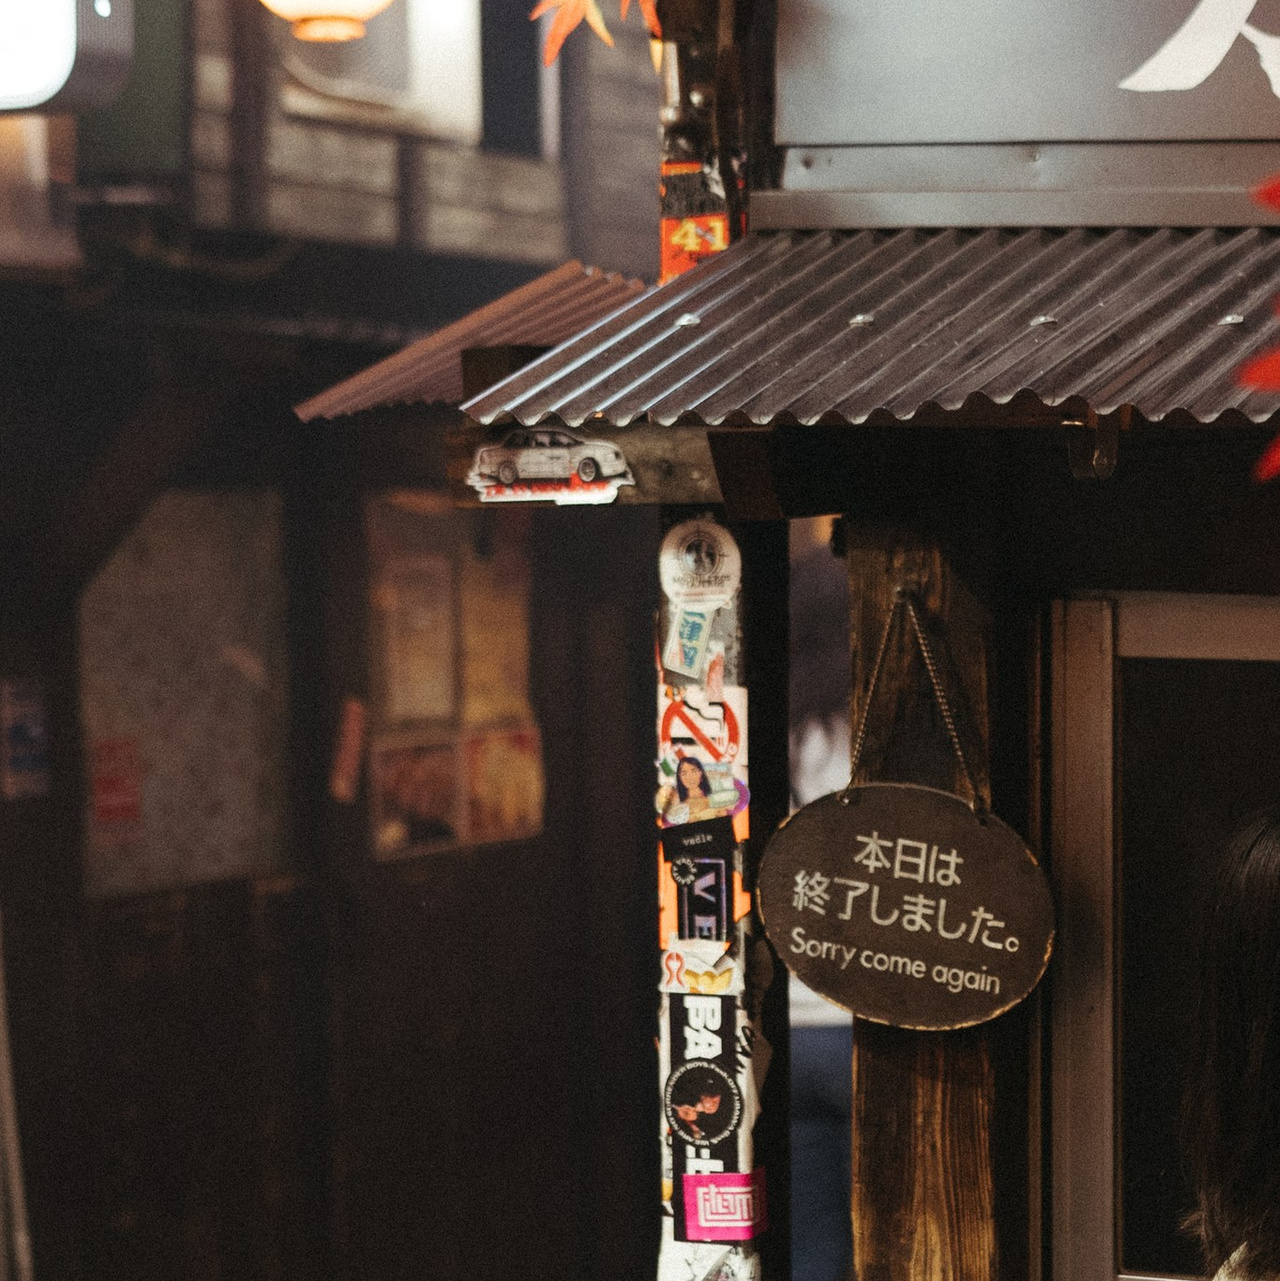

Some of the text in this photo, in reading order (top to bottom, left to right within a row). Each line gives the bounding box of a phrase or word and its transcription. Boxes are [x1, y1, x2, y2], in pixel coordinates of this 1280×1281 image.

[853, 830, 964, 887] 本日は
[792, 870, 1020, 953] 終了しました。
[790, 927, 1001, 994] Sorry come again
